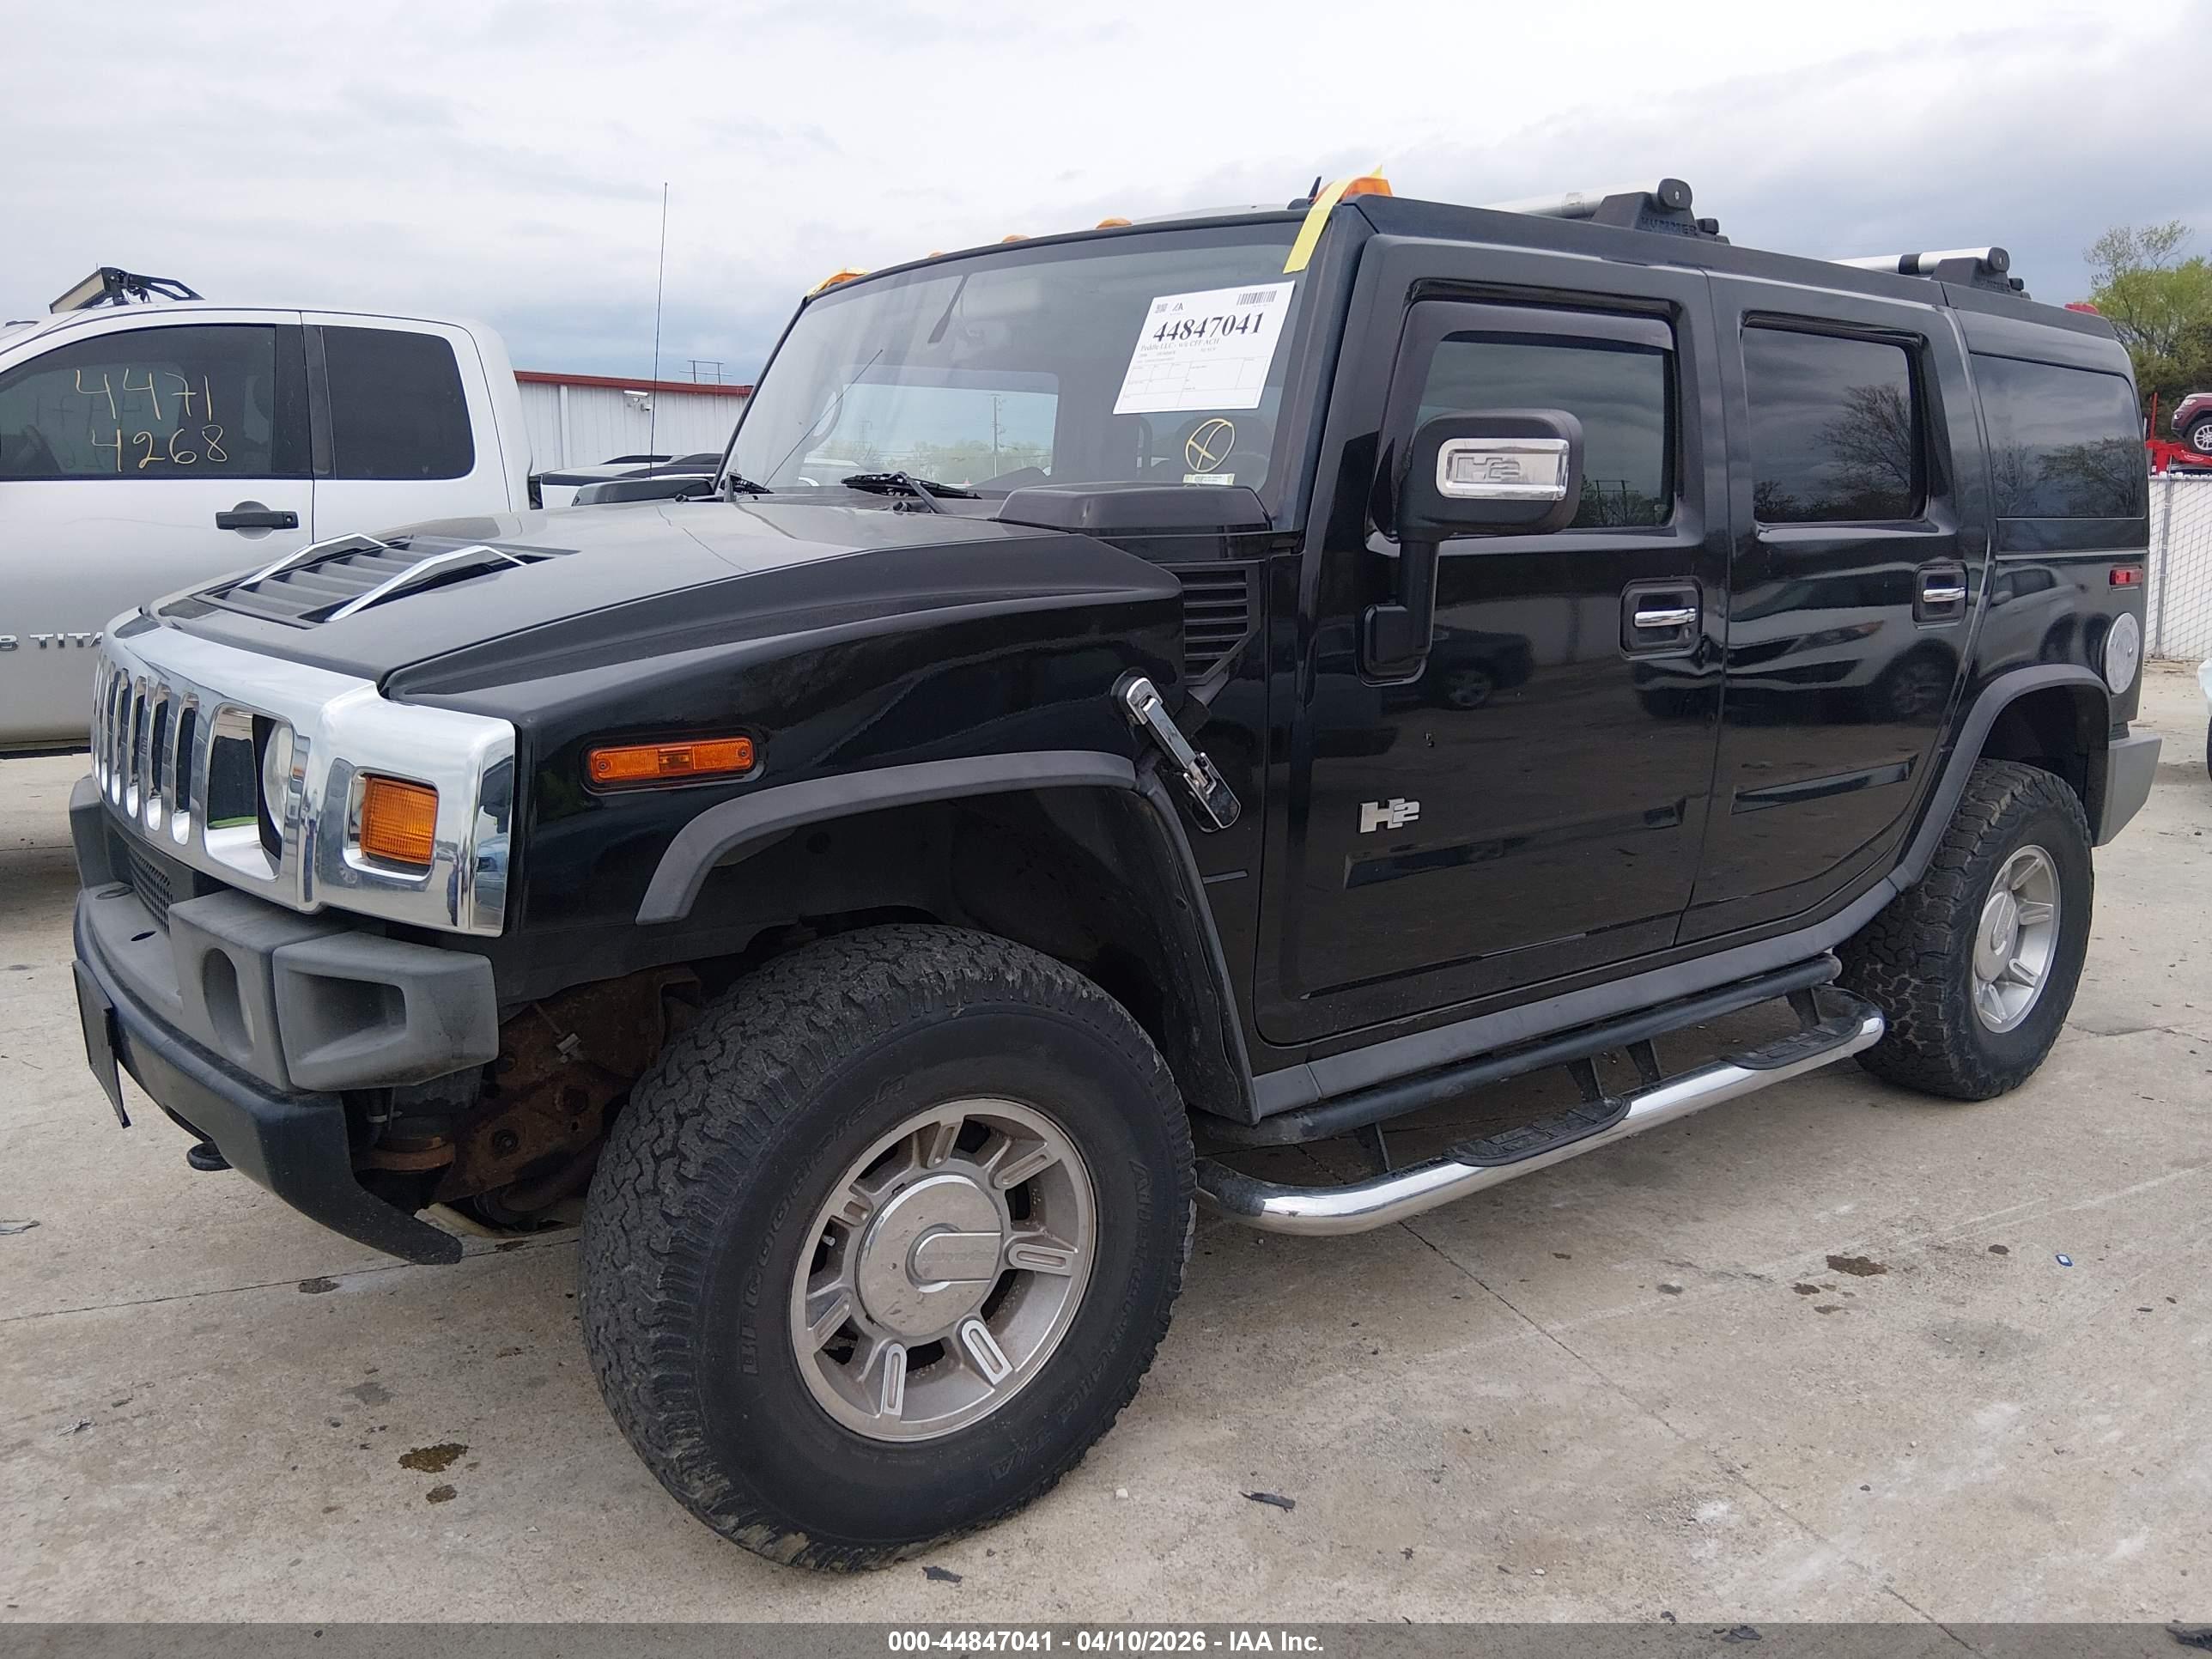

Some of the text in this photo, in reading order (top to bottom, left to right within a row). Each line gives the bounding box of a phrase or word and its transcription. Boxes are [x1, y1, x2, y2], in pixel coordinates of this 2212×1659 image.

[1152, 312, 1265, 343] 44847041
[76, 368, 217, 422] 4471
[91, 424, 228, 473] 4268
[1456, 456, 1521, 480] H2
[1358, 797, 1420, 834] H2
